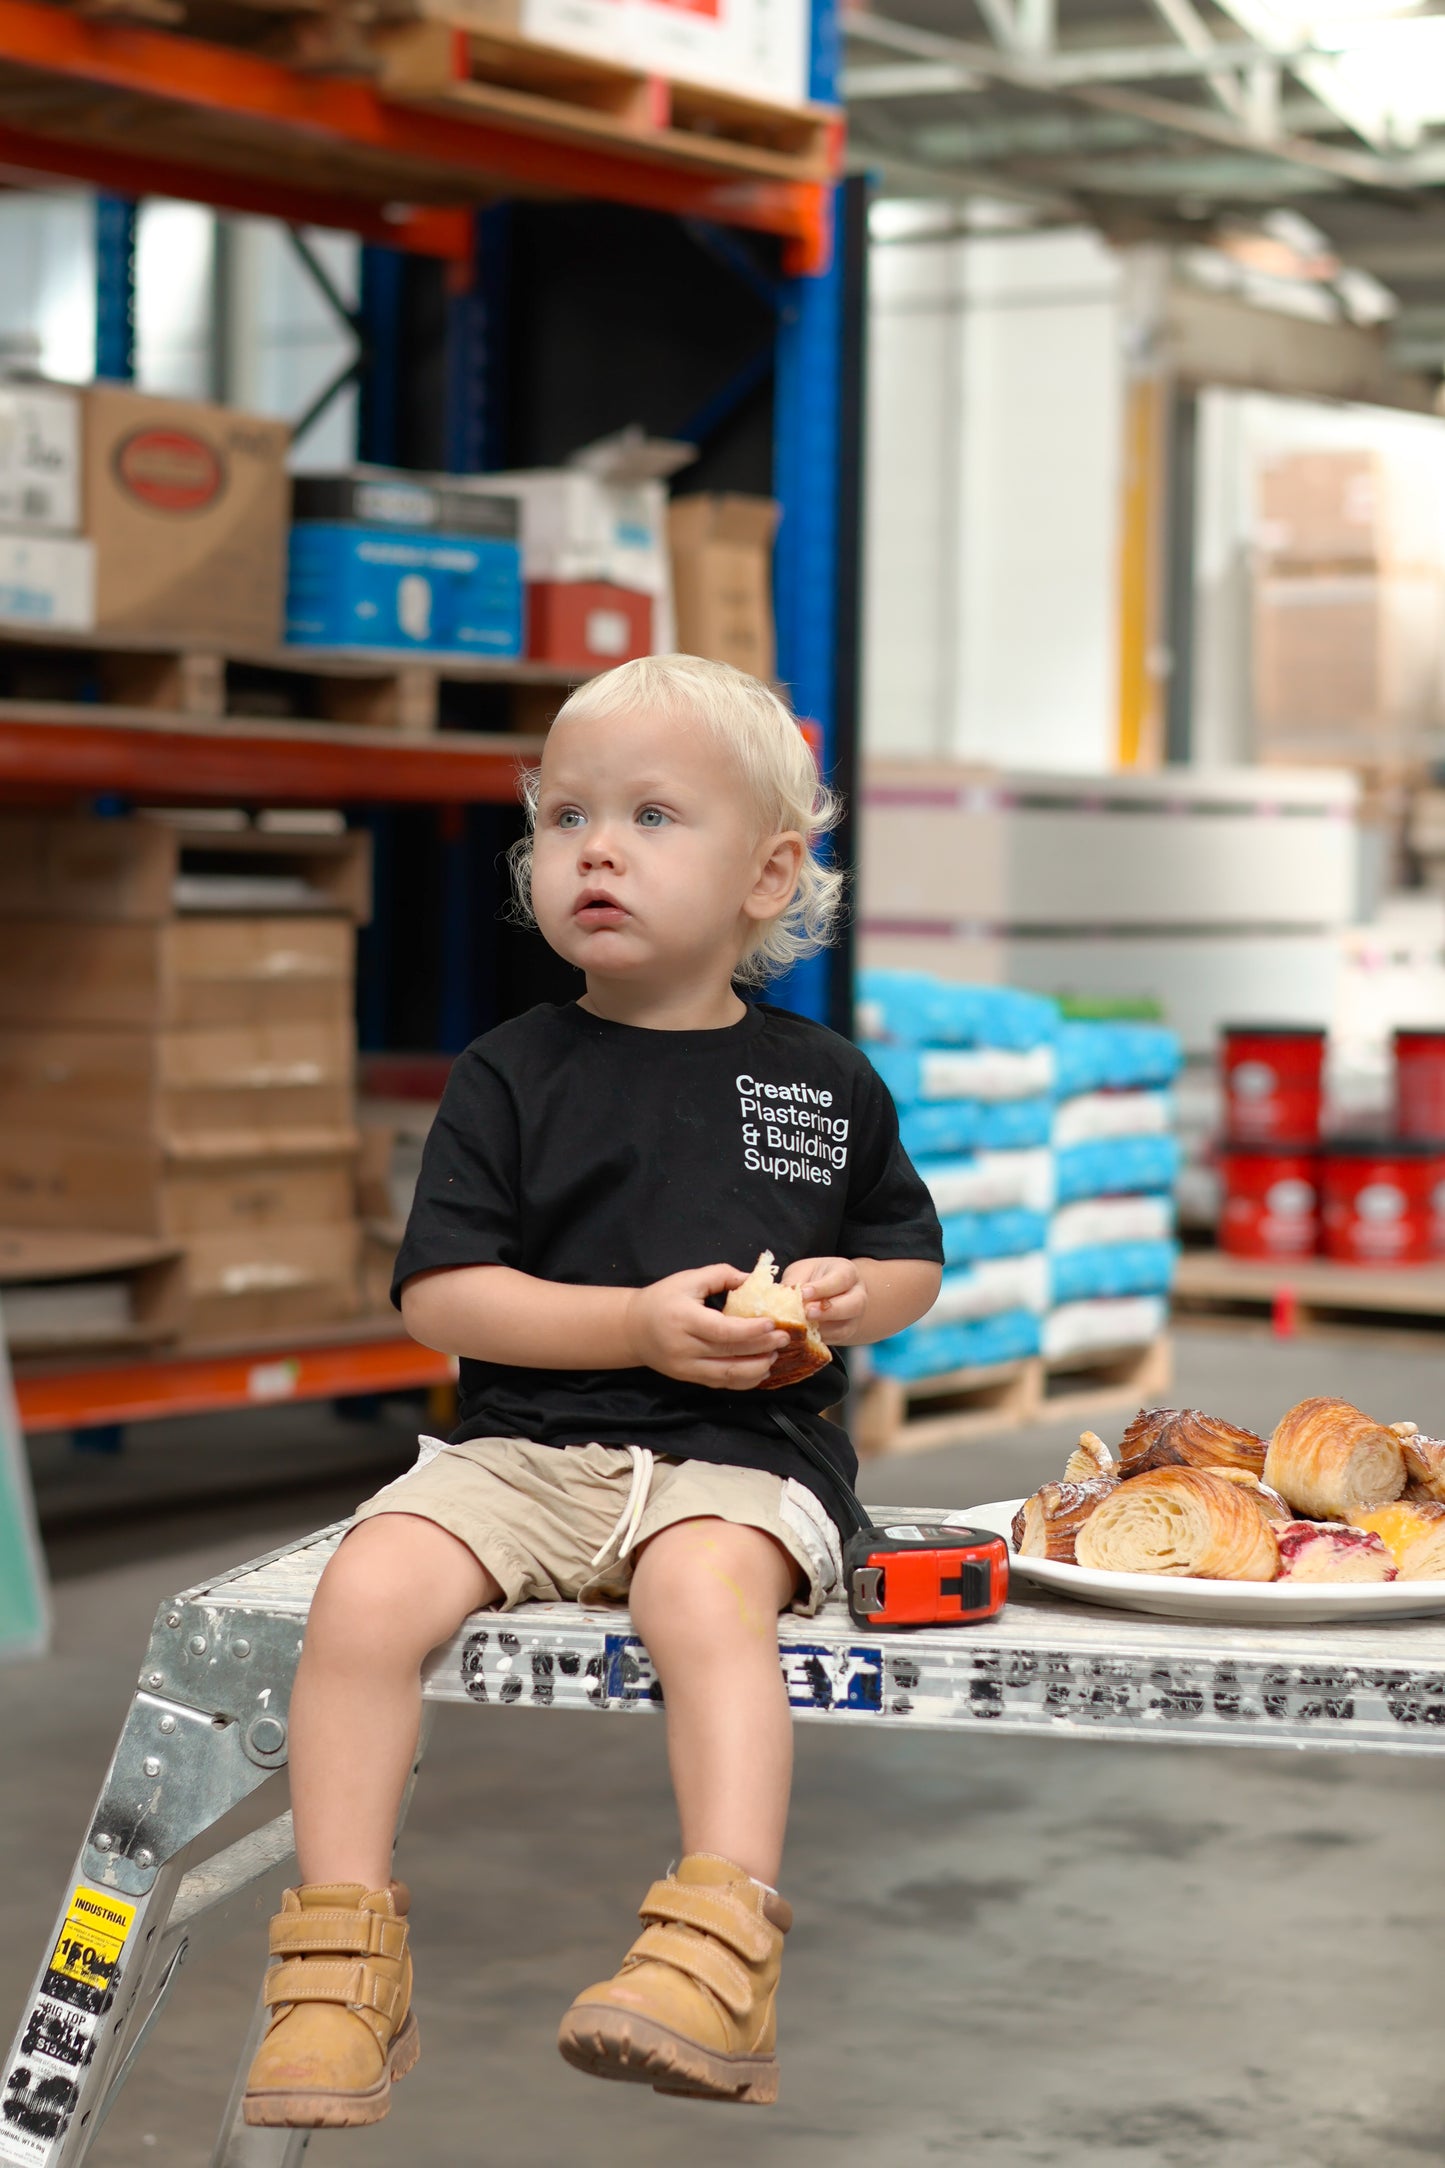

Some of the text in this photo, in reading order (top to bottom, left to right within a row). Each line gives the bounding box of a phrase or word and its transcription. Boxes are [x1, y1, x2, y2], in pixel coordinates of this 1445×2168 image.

[735, 1074, 833, 1108] Creative
[740, 1097, 849, 1142] Plastering
[741, 1123, 848, 1170] & Building
[743, 1148, 832, 1186] Supplies
[74, 1897, 127, 1928] INDUSTRIAL
[46, 2002, 87, 2026] BIG TOP
